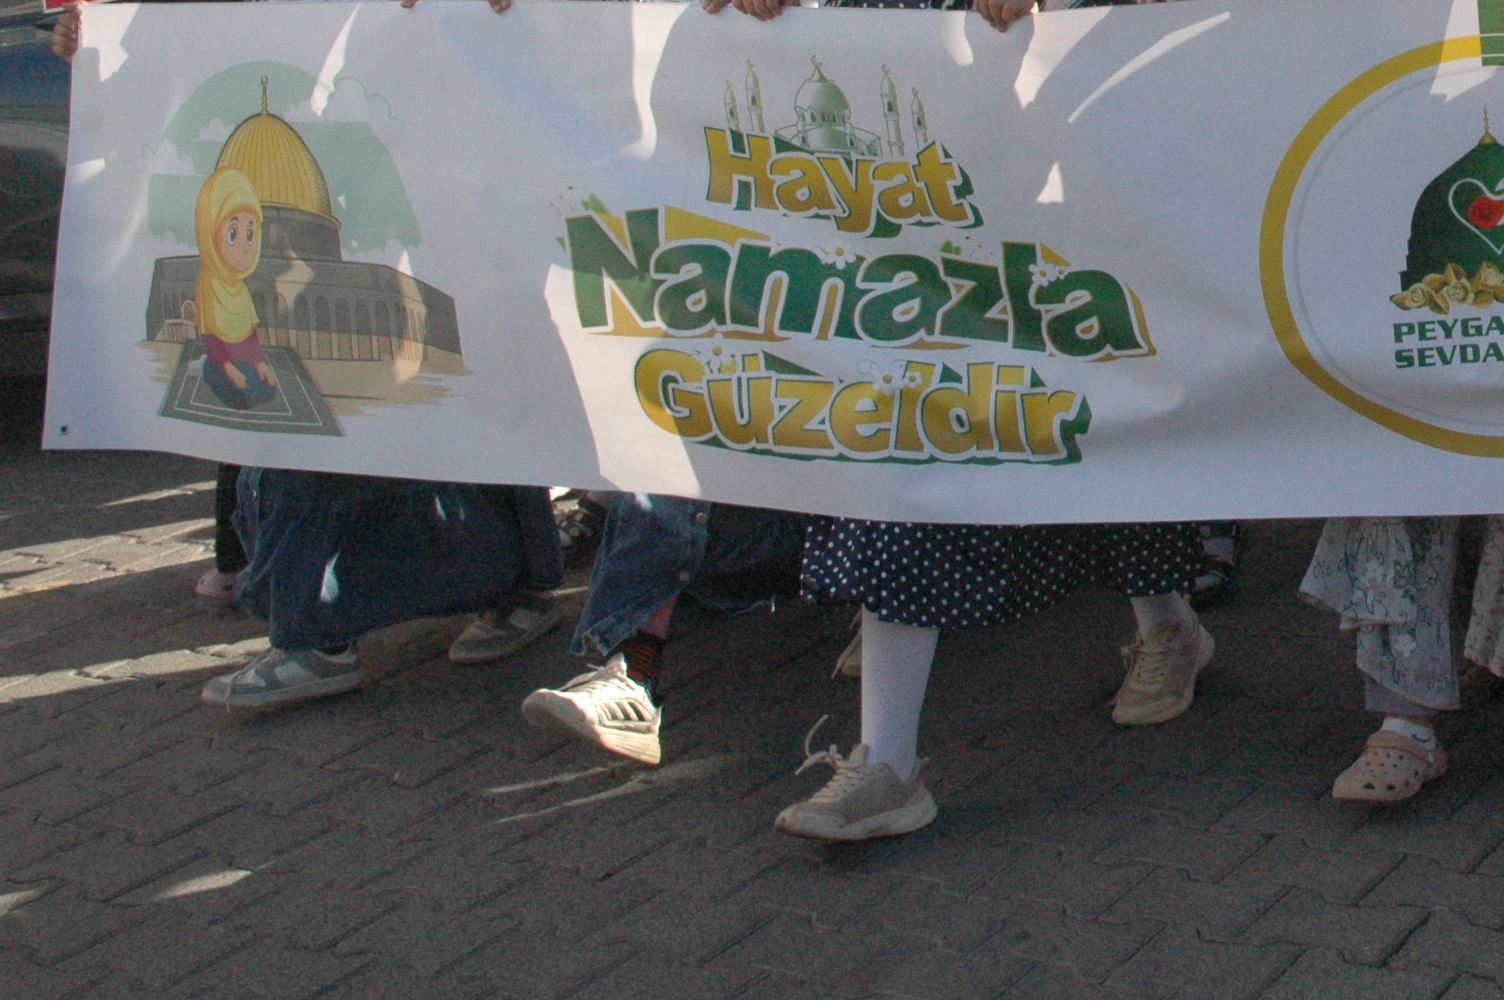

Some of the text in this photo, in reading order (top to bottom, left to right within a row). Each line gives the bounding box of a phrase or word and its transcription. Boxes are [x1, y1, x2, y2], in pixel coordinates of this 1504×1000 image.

[703, 125, 979, 237] Hayat
[564, 205, 1150, 358] Namazla
[634, 348, 1088, 461] Güzeldir
